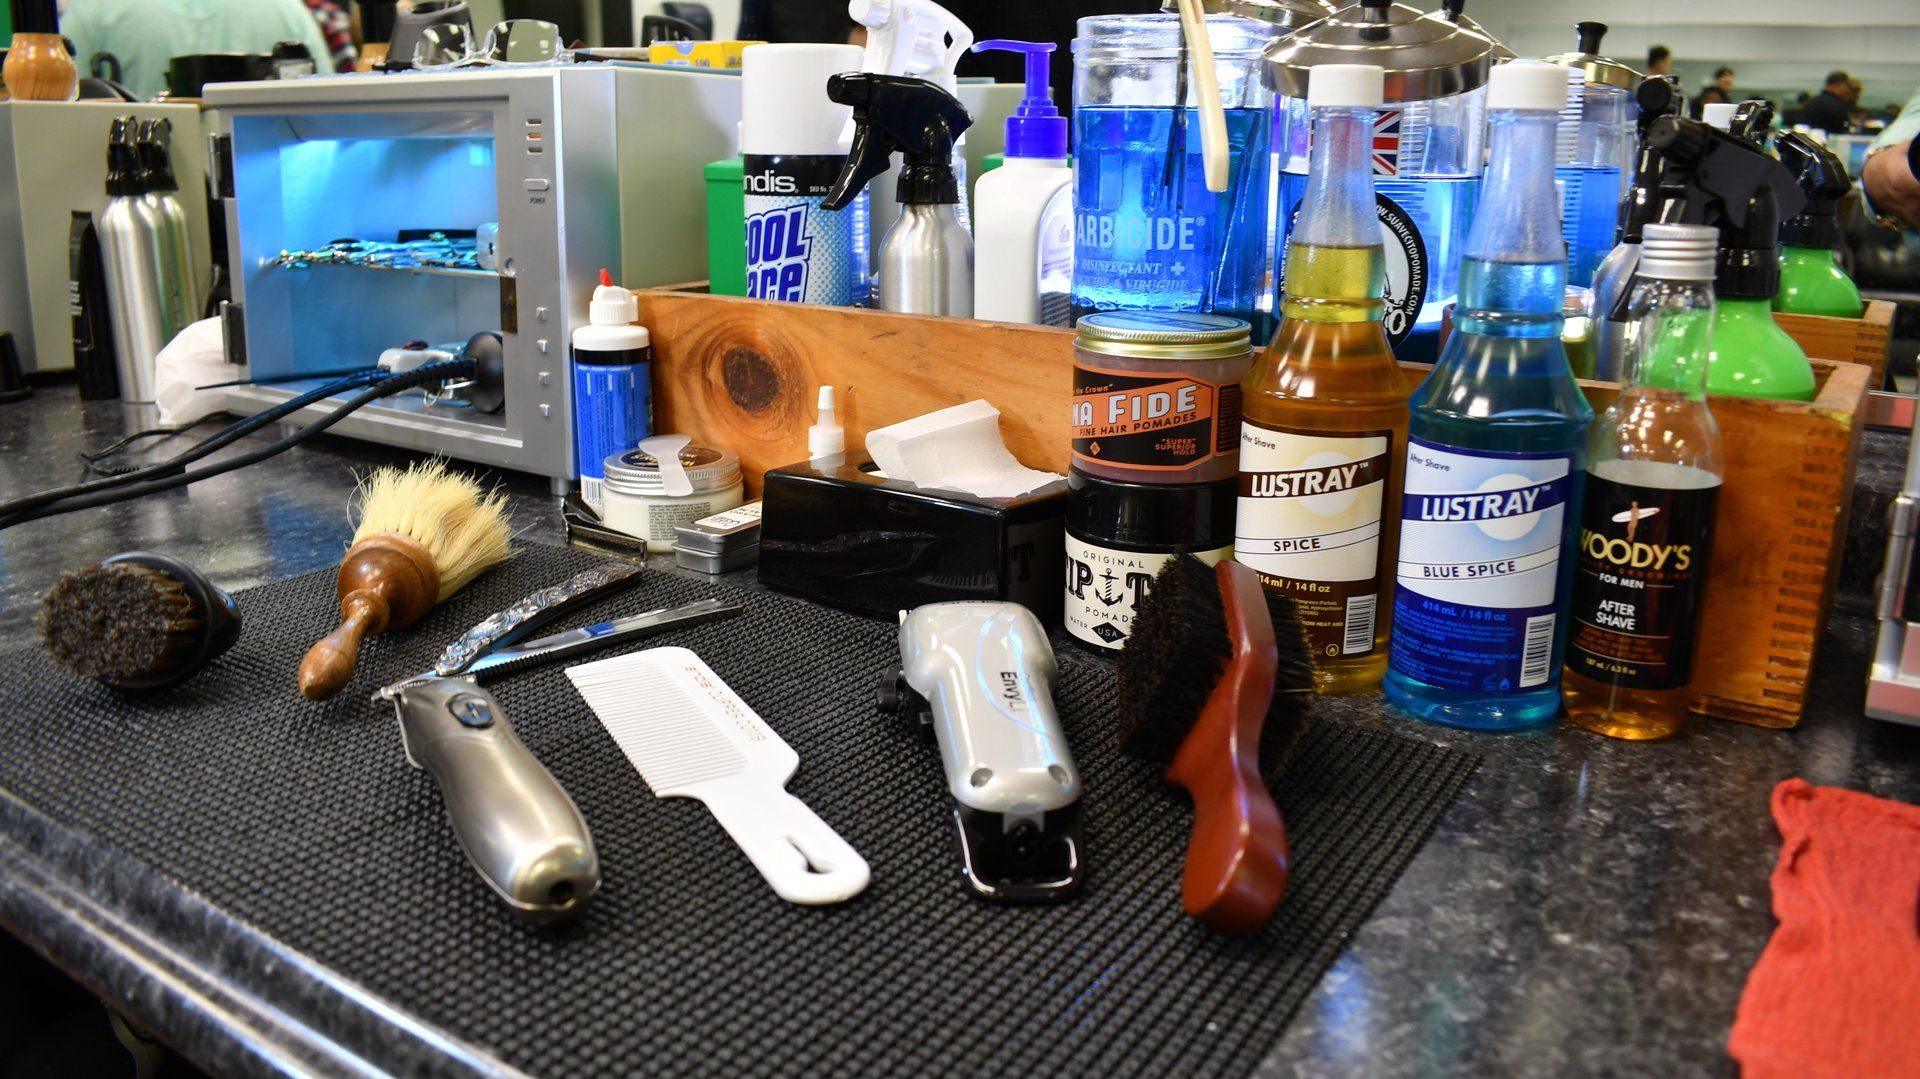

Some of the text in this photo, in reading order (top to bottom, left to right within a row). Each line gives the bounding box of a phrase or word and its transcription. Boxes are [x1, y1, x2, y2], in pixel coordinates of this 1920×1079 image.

[745, 205, 811, 267] OOL
[1107, 385, 1198, 424] FIDE
[1079, 411, 1197, 436] FINE HAIR POMADES
[1155, 443, 1196, 451] SUPERIOR
[1254, 437, 1276, 450] Shave
[1425, 459, 1451, 472] Shave
[1274, 538, 1321, 552] SPICE
[1083, 550, 1145, 569] ORIGINAL
[1423, 560, 1516, 578] BLUE SPICE
[1066, 556, 1094, 601] IP
[1295, 582, 1308, 592] 14
[1309, 583, 1317, 592] fl
[1318, 585, 1331, 593] oz
[1599, 573, 1645, 590] FOR MEN
[1422, 600, 1440, 613] 414
[1441, 606, 1457, 616] mL
[1469, 610, 1482, 620] 14
[1484, 611, 1492, 620] fl
[1494, 613, 1508, 622] oz
[1598, 599, 1636, 617] AFTER
[1070, 615, 1088, 629] WATER
[1595, 611, 1637, 631] SHAVE
[1097, 626, 1118, 638] USA
